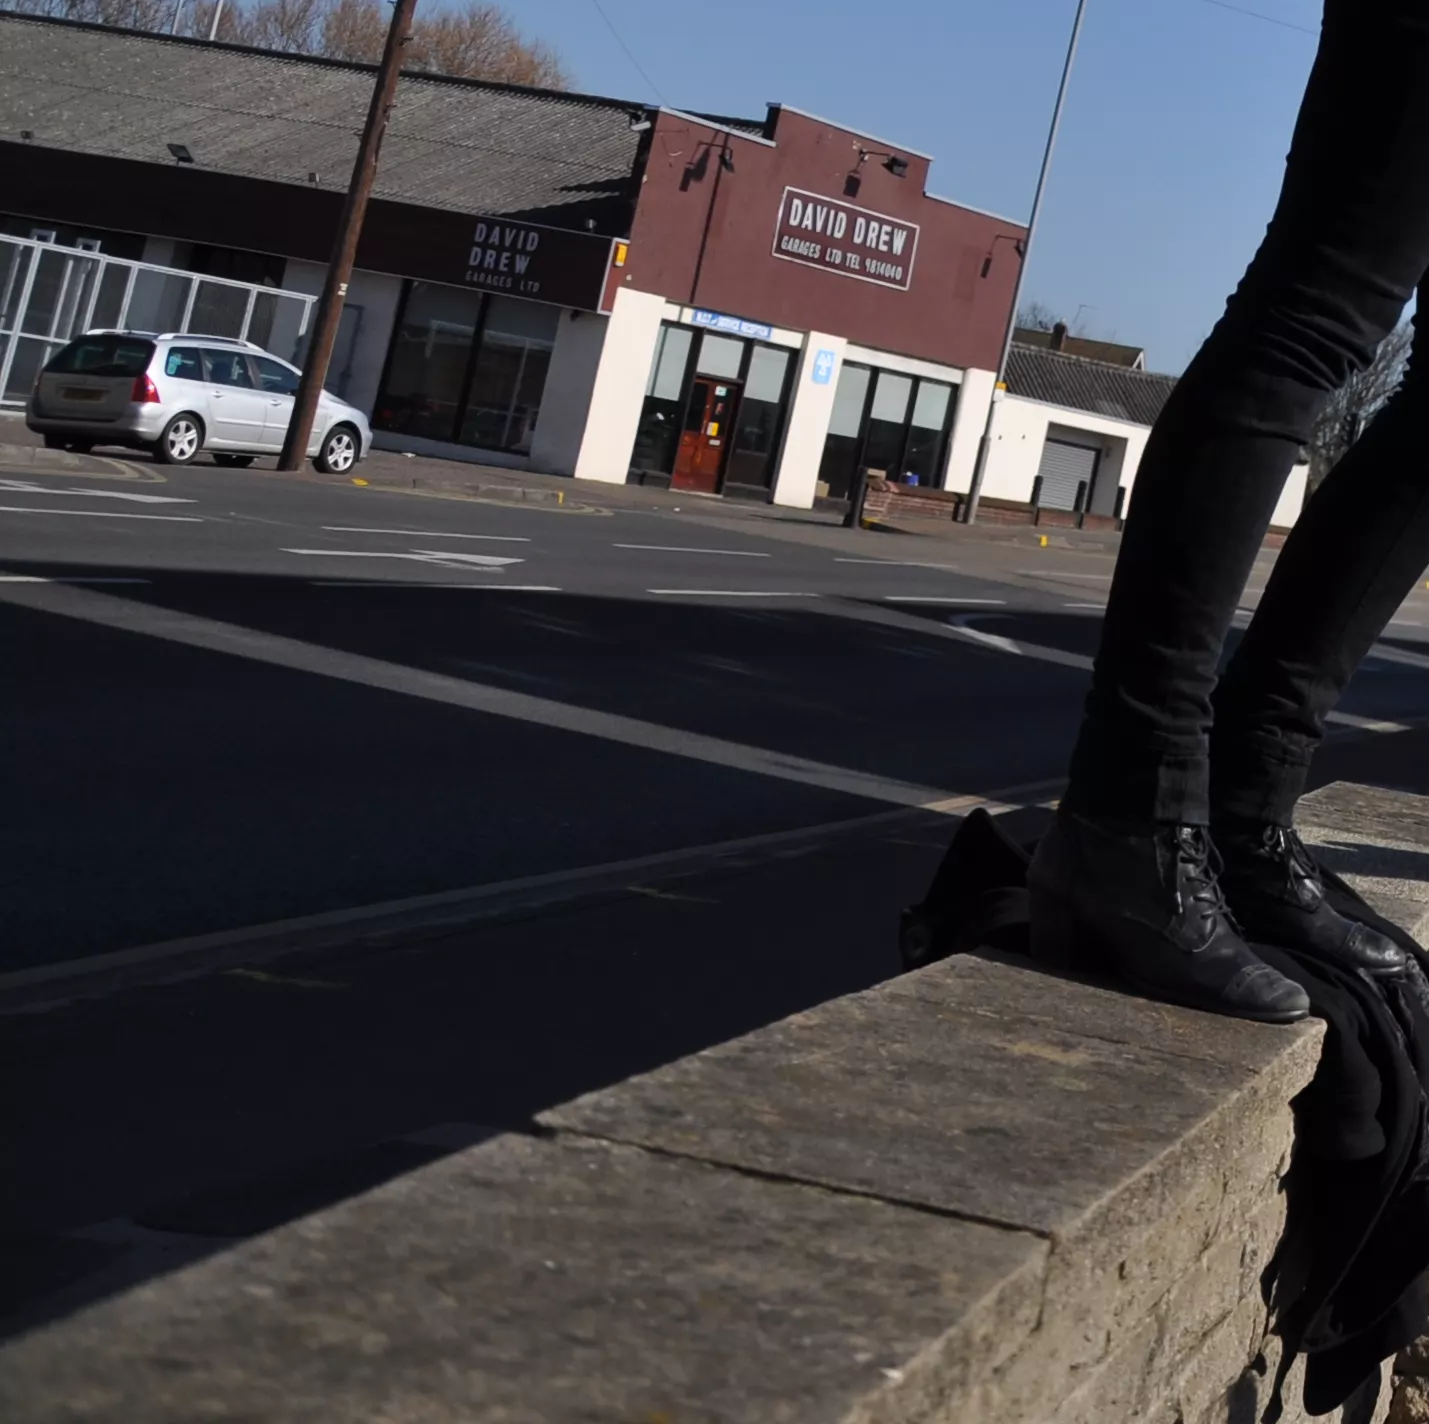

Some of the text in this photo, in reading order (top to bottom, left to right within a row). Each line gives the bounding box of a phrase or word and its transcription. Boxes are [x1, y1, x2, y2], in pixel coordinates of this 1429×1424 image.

[475, 223, 539, 251] DAVID
[789, 198, 907, 255] DAVID DREW
[469, 246, 530, 274] DREW
[781, 235, 821, 259] GARAGES
[825, 248, 842, 264] LTD
[845, 253, 860, 269] TEL
[466, 270, 540, 292] GARAGES LTD
